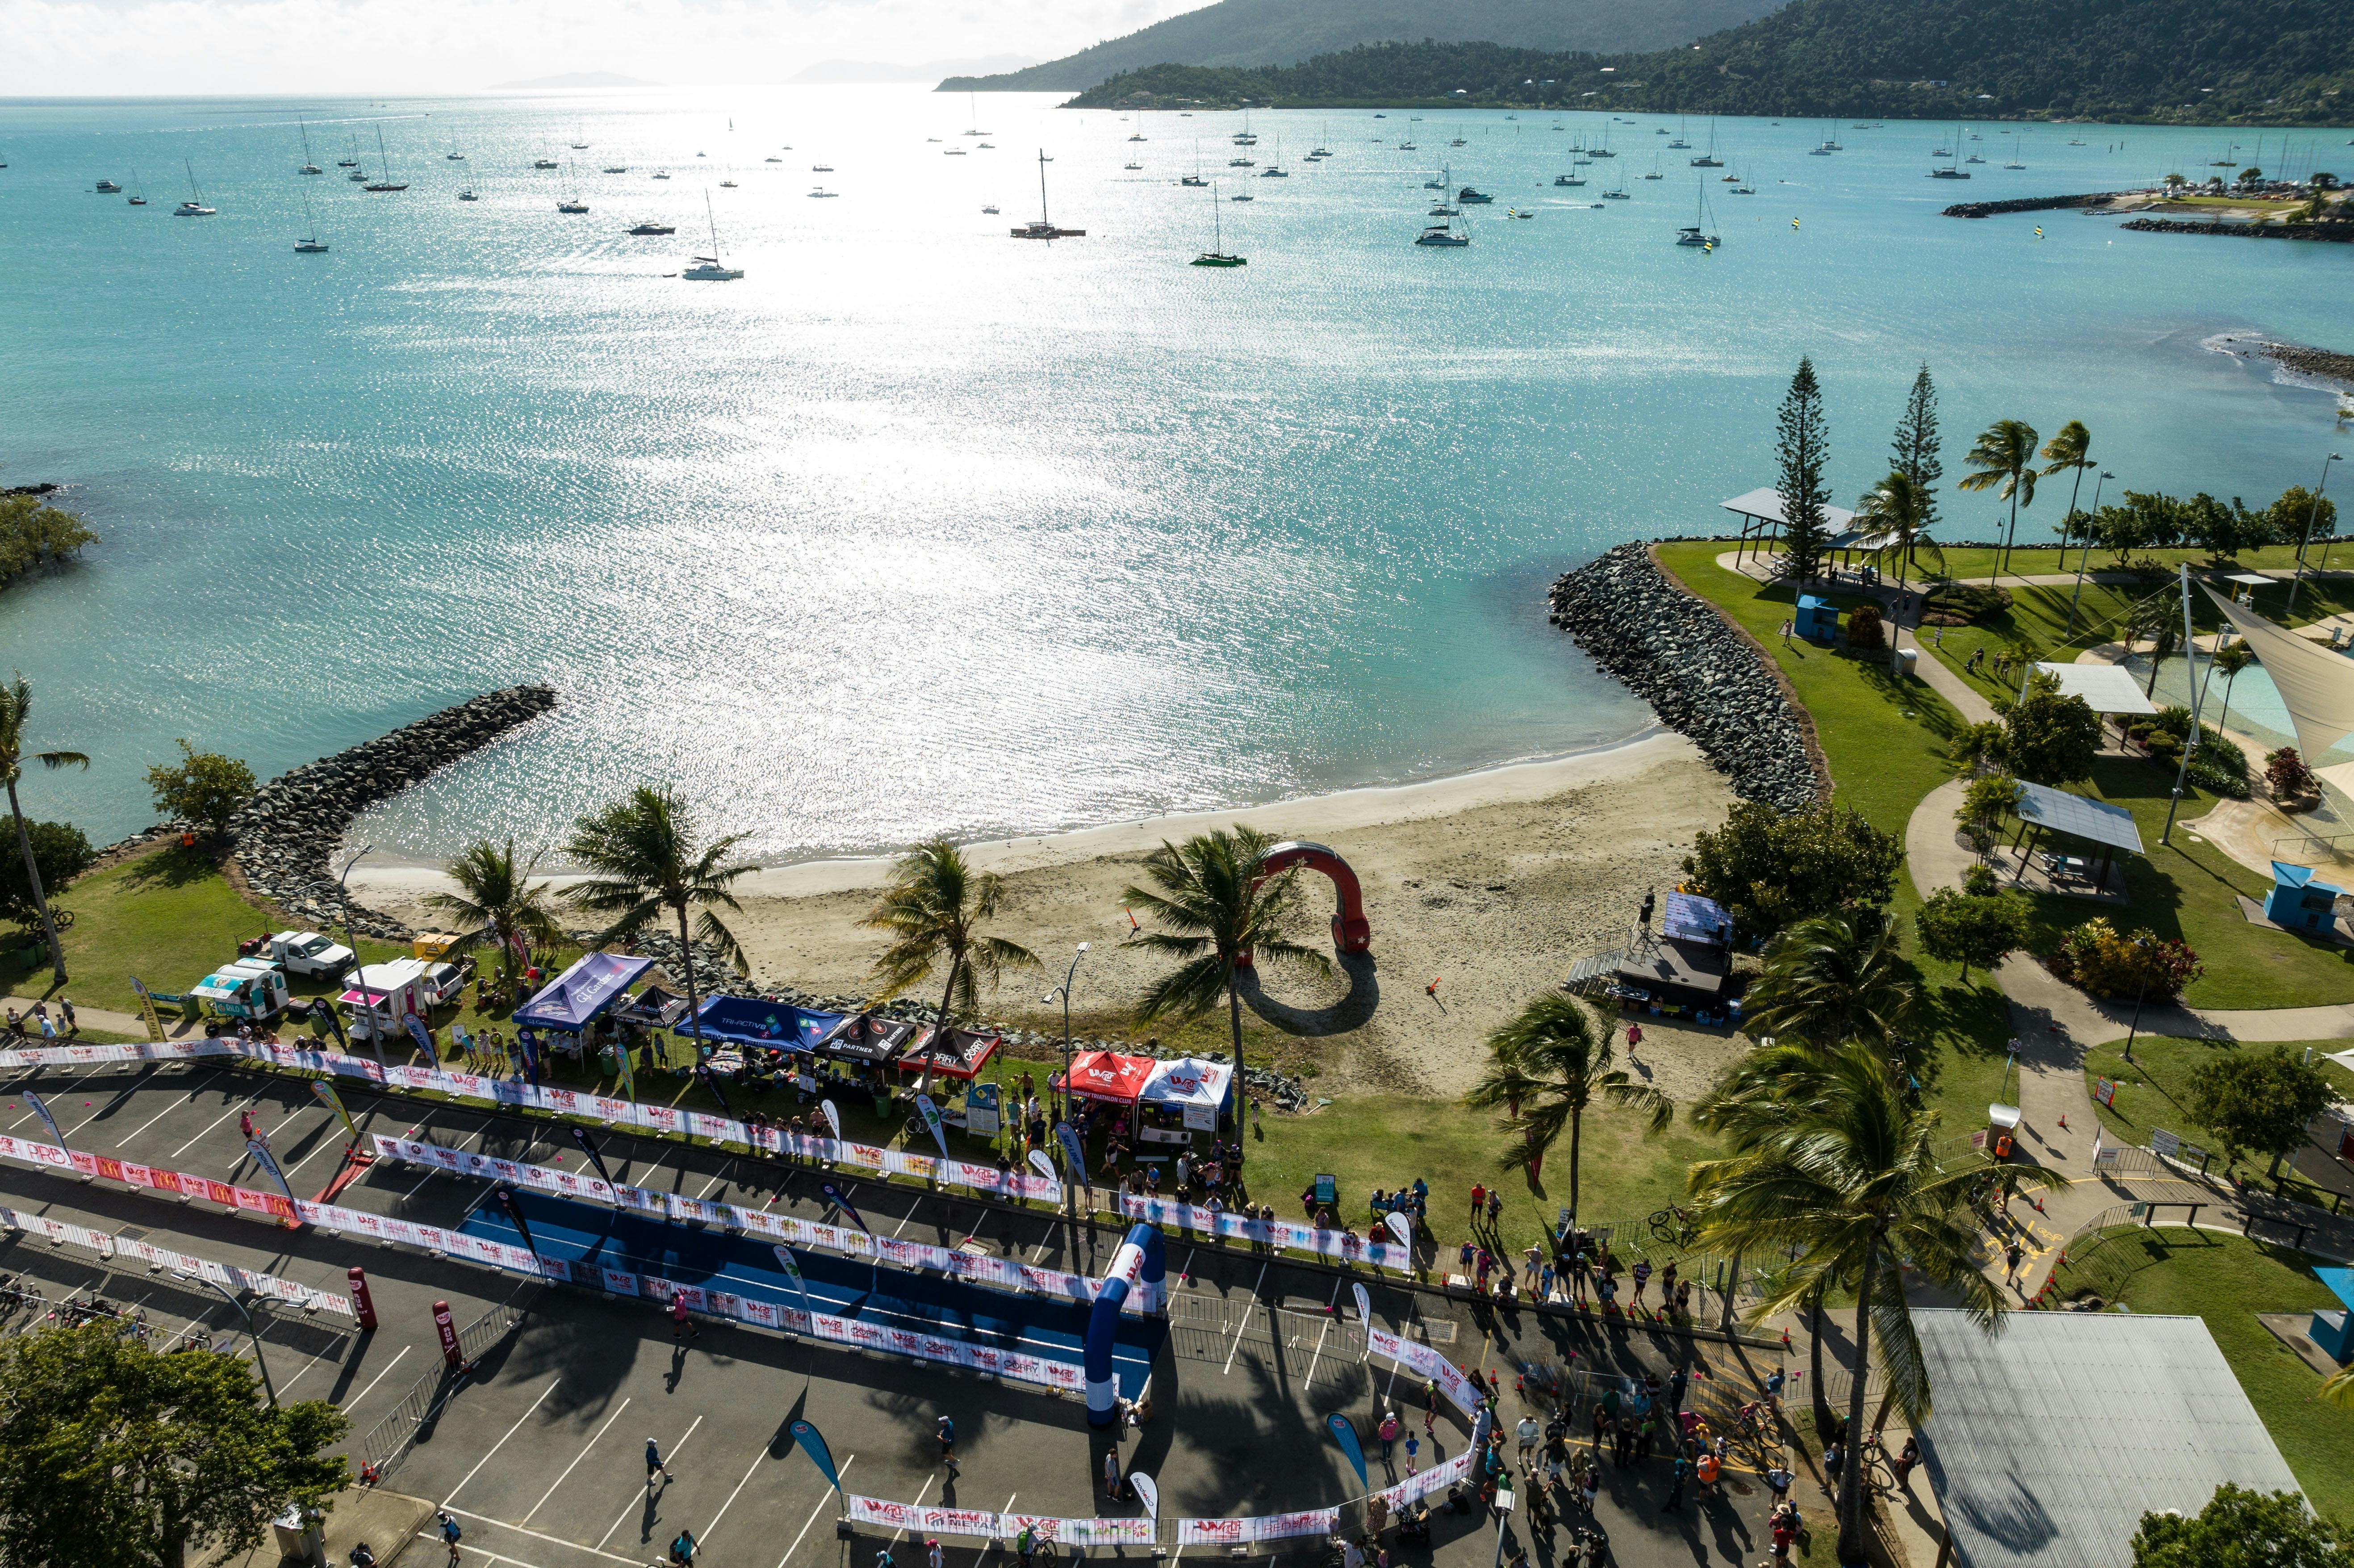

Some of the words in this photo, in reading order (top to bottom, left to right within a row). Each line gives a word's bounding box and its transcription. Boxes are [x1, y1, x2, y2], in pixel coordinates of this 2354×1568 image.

[140, 995, 160, 1041] SMOOTHIES
[722, 1018, 766, 1030] TRI-ACTIV8
[409, 1025, 431, 1051] SEALINK
[887, 1027, 905, 1043] PARTNER
[843, 1043, 873, 1053] PARTNER
[1059, 1087, 1091, 1097] WHSUNDAY
[1091, 1093, 1118, 1102] TRIATHLON
[1062, 1134, 1082, 1165] SEALINK
[1012, 1182, 1045, 1192] BEAUMONT
[354, 1293, 362, 1308] RUN
[443, 1327, 454, 1342] RUN
